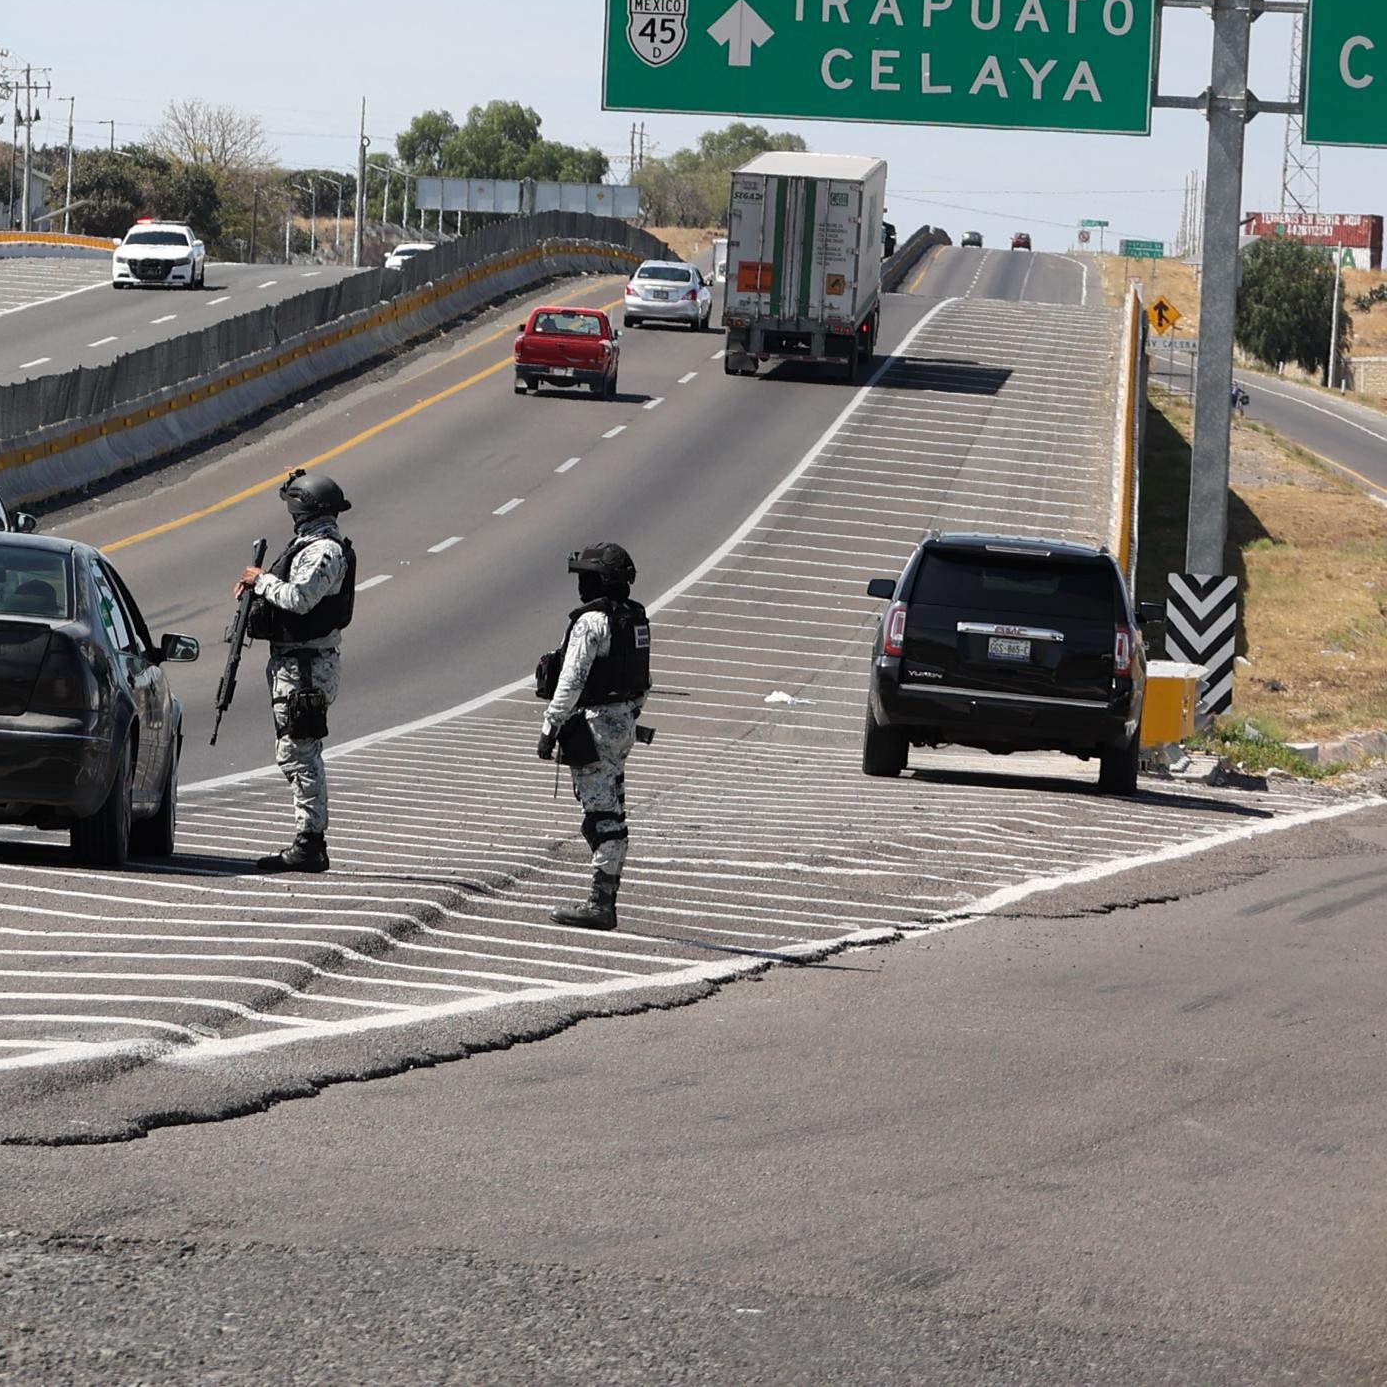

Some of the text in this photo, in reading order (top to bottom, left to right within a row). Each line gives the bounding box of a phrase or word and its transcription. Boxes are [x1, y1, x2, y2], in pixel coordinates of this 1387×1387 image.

[638, 18, 676, 44] 45
[653, 46, 662, 59] D
[1339, 35, 1375, 89] C
[821, 48, 1102, 102] CELAYA
